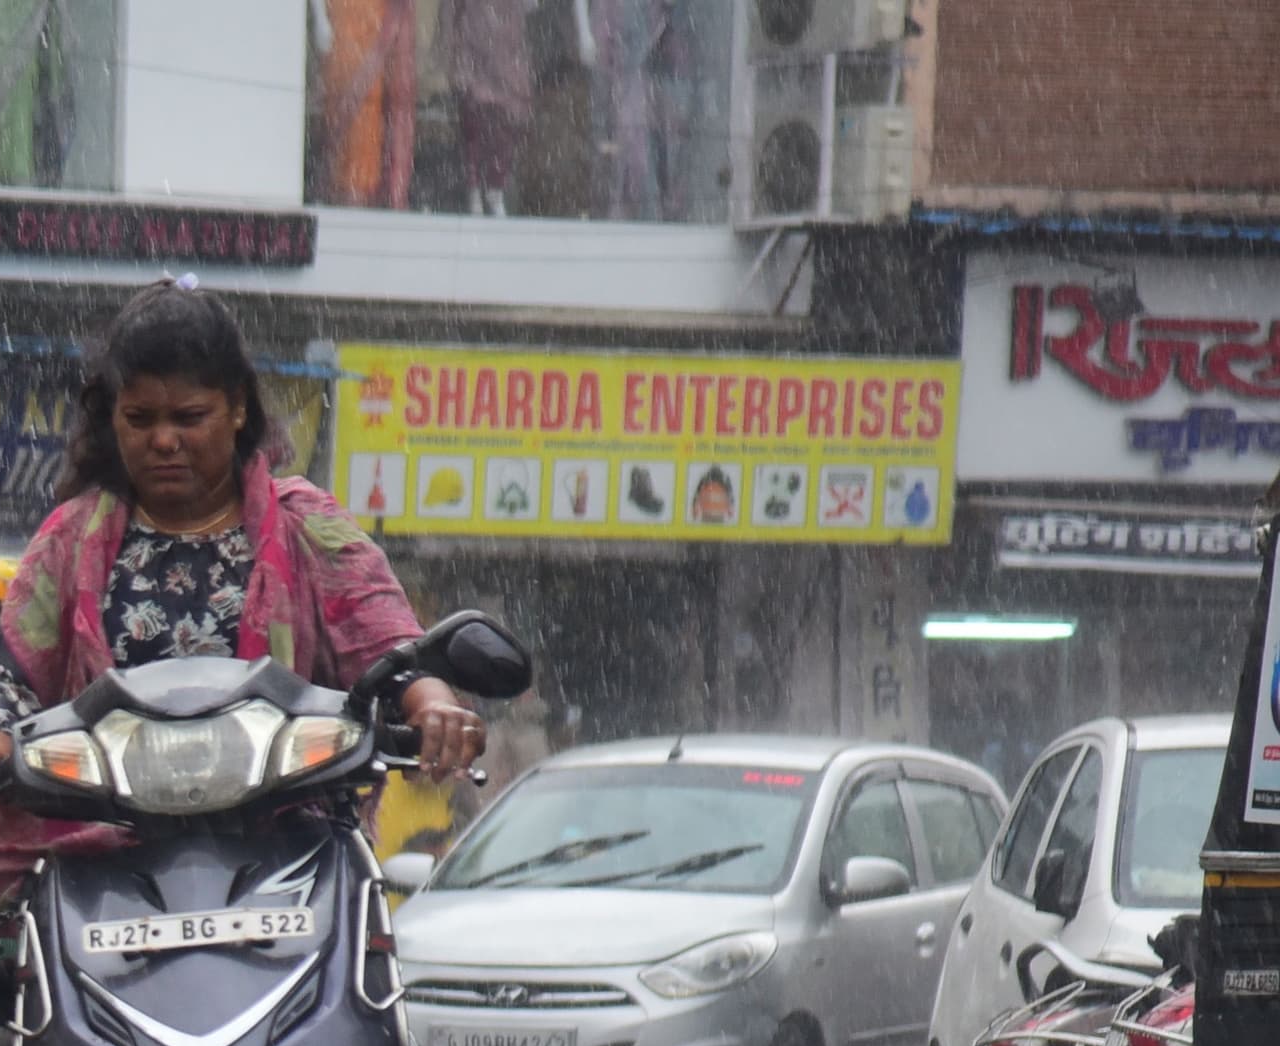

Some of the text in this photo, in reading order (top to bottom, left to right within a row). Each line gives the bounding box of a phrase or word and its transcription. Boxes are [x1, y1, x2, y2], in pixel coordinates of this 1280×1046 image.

[404, 364, 945, 441] SHARDA ENTERPRISES
[89, 914, 307, 948] RJ27 BG 522
